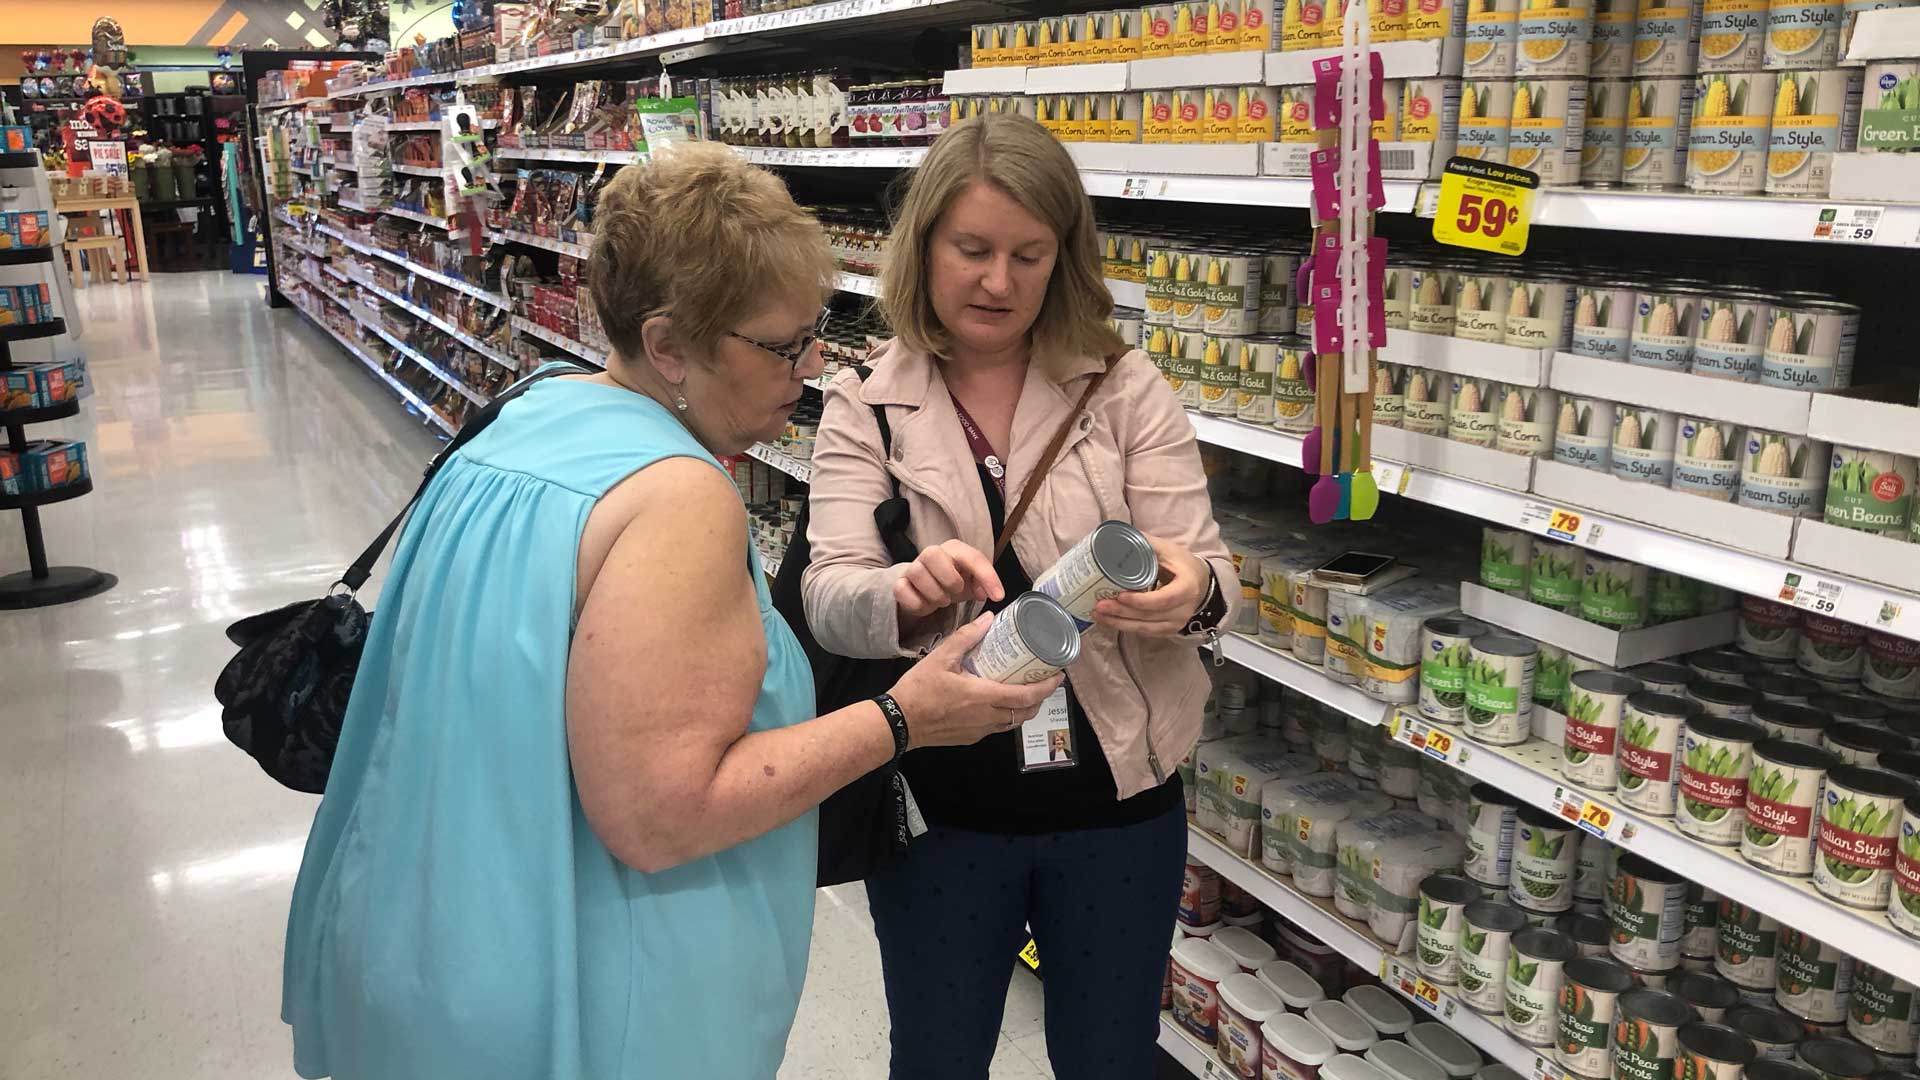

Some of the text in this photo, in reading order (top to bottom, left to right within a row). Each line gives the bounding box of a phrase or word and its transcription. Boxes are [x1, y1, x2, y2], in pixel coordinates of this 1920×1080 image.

[1416, 18, 1440, 28] Corn
[1703, 15, 1758, 31] eam Style
[1800, 9, 1835, 26] Style
[1379, 21, 1404, 31] Corn
[1478, 26, 1505, 40] Style
[1548, 22, 1578, 37] Style
[1648, 22, 1676, 37] Style
[1216, 36, 1238, 46] Corn
[1244, 33, 1262, 42] Corn
[1298, 31, 1321, 40] Corn
[1118, 44, 1136, 54] Corn
[1150, 42, 1170, 51] Corn
[1088, 126, 1106, 136] Corn
[1114, 126, 1132, 136] Corn
[1150, 126, 1170, 135] Corn
[1178, 126, 1196, 136] Corn
[1210, 126, 1231, 134] Corn
[1244, 124, 1266, 134] Corn
[1288, 125, 1310, 135] Corn
[1407, 126, 1428, 134] Corn
[1864, 125, 1910, 142] Green
[1470, 131, 1496, 145] Style
[1522, 132, 1552, 146] Style
[1634, 130, 1663, 146] Style
[1718, 131, 1754, 148] Style
[1788, 131, 1824, 148] Style
[1487, 168, 1504, 178] Low
[1456, 194, 1519, 238] 59¢
[1848, 228, 1874, 240] .59
[1217, 292, 1238, 302] Gold
[1385, 310, 1402, 318] orn
[1471, 320, 1498, 330] Corn
[1518, 328, 1546, 338] Corn
[1588, 340, 1616, 354] Style
[1176, 364, 1196, 374] Gold
[1723, 358, 1756, 373] Style
[1216, 372, 1238, 382] Gold
[1246, 378, 1266, 388] Gold
[1782, 368, 1818, 386] Style
[1418, 409, 1444, 421] Corn
[1470, 420, 1496, 432] Corn
[1514, 429, 1542, 442] Corn
[1568, 449, 1598, 464] Style
[1630, 461, 1662, 478] Style
[1776, 489, 1810, 508] Style
[1552, 513, 1580, 532] .79
[1852, 506, 1903, 526] Beans
[1811, 600, 1834, 612] .59
[1478, 694, 1514, 710] Beans
[1428, 732, 1450, 752] .79
[1576, 727, 1604, 744] Style
[1631, 752, 1660, 770] Style
[1710, 782, 1744, 800] Style
[1584, 806, 1610, 826] .79
[1763, 804, 1798, 826] Style
[1854, 840, 1892, 860] Style
[1516, 860, 1568, 880] Sweet Peas
[1620, 904, 1644, 924] Peas
[1732, 924, 1761, 944] Peas
[1430, 937, 1454, 952] Peas
[1468, 964, 1493, 979] Peas
[1792, 954, 1820, 974] Peas
[1418, 982, 1438, 1002] .79
[1865, 984, 1895, 1004] Peas
[1518, 994, 1544, 1011] Peas
[1568, 1016, 1594, 1035] Peas
[1631, 1050, 1660, 1072] Peas
